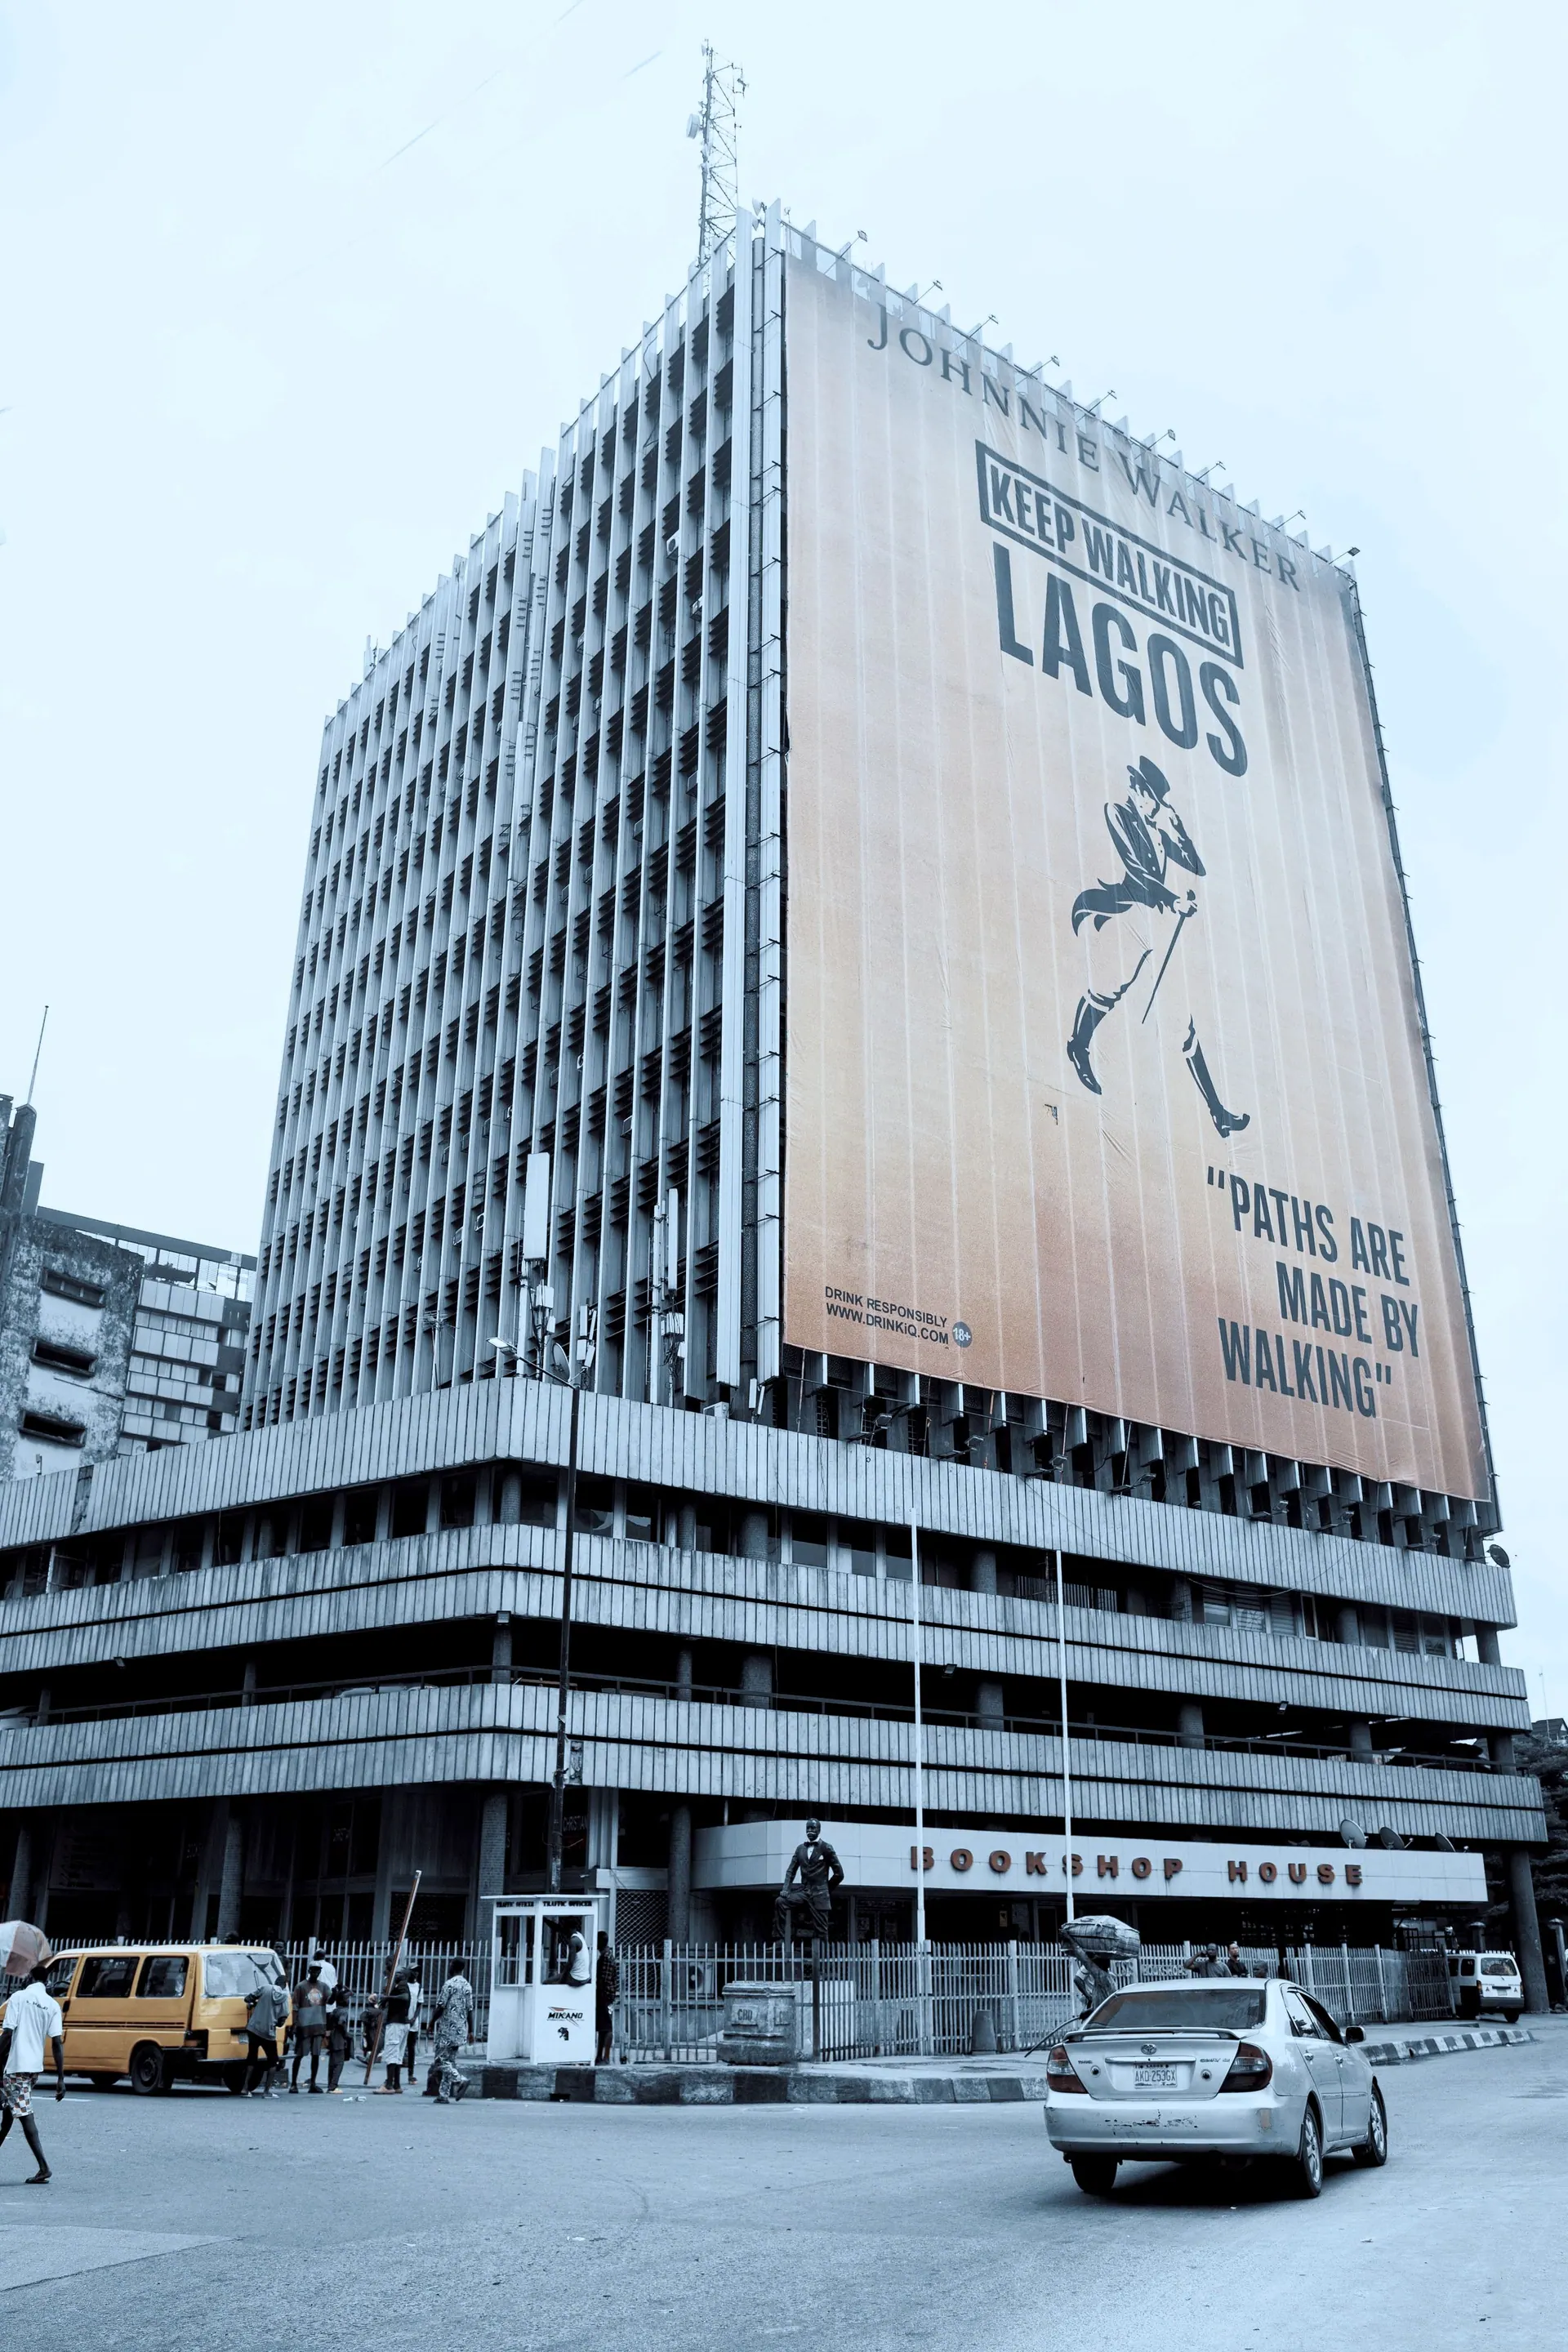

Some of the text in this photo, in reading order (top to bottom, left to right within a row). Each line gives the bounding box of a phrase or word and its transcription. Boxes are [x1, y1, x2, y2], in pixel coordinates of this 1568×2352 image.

[866, 303, 1300, 591] JOHNNIE WALKER
[990, 465, 1230, 647] KEEP WALKING
[993, 541, 1248, 777] LAGOS
[1350, 1216, 1410, 1286] ARE
[825, 1285, 947, 1328] DRINK RESPONSIBLY
[952, 1326, 971, 1342] 18+
[1276, 1261, 1419, 1358] MADE BY
[911, 1846, 1362, 1884] BOOKSHOP HOUSE
